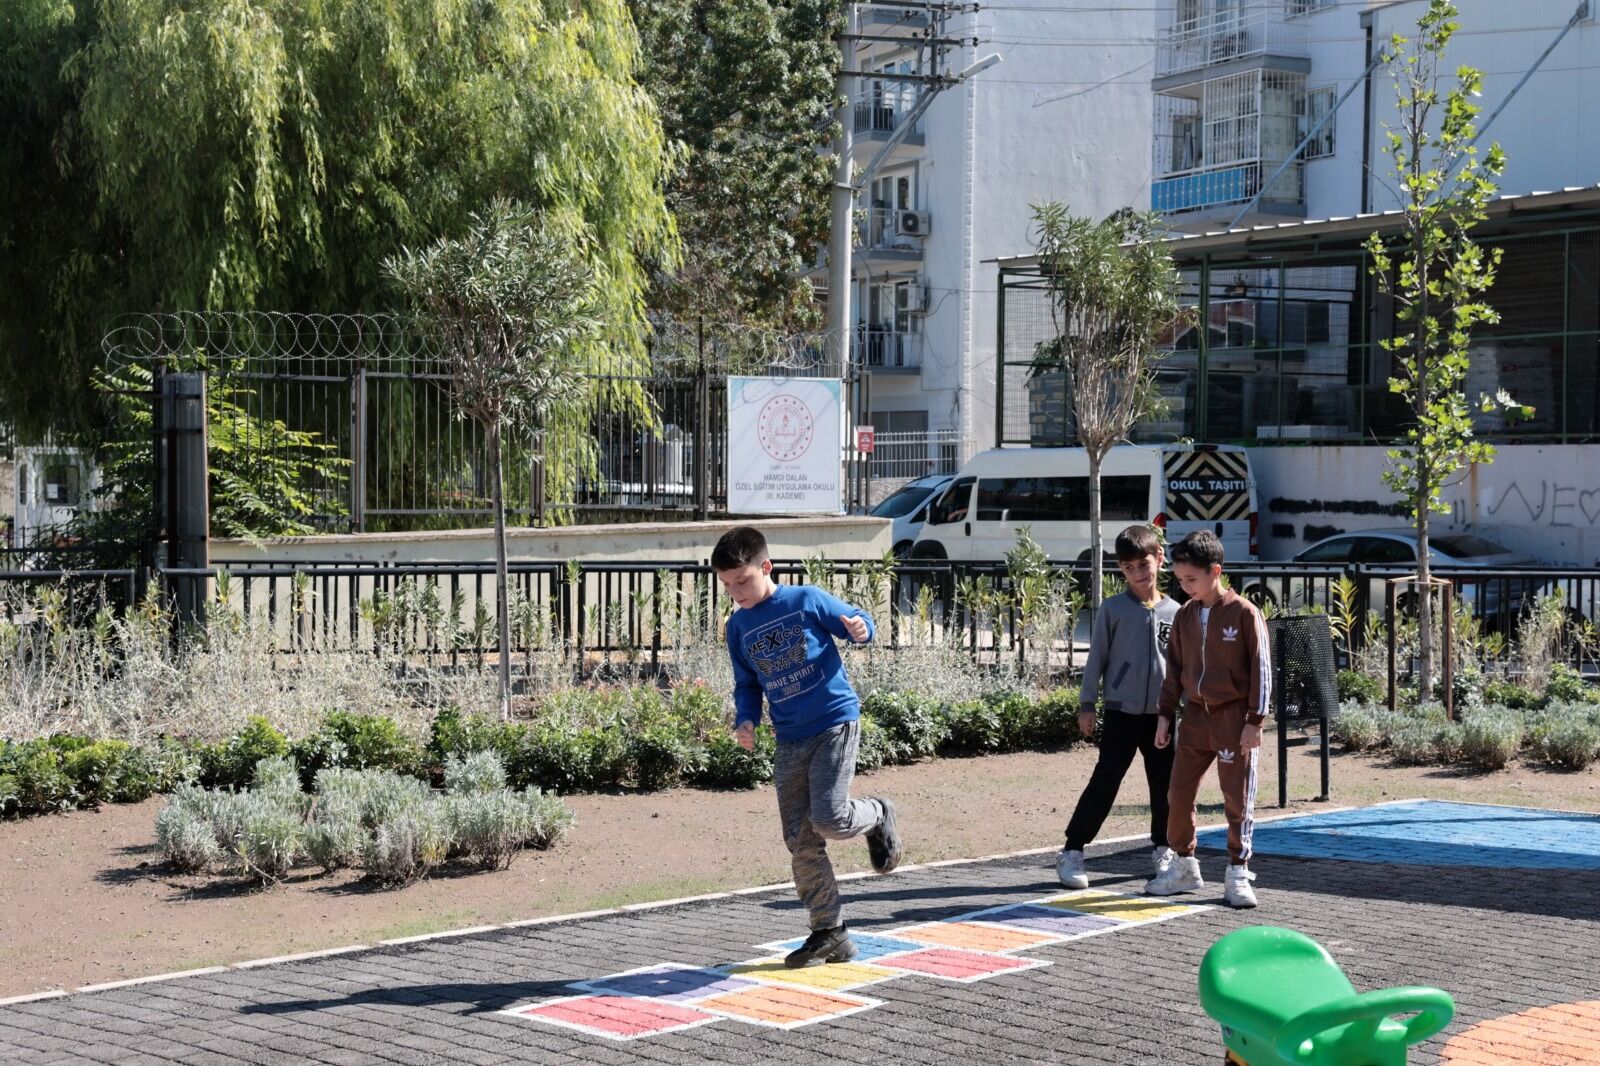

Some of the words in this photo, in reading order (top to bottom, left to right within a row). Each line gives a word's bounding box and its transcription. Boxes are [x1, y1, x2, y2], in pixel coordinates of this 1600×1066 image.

[785, 473, 808, 481] DALAN
[735, 481, 752, 491] ÖZEL
[776, 482, 812, 491] UYGULAMA
[813, 482, 836, 491] OKULU
[1170, 480, 1203, 490] OKUL
[1208, 480, 1245, 492] TAŞITI
[748, 624, 803, 656] MEXICO
[788, 663, 816, 683] SPIRIT
